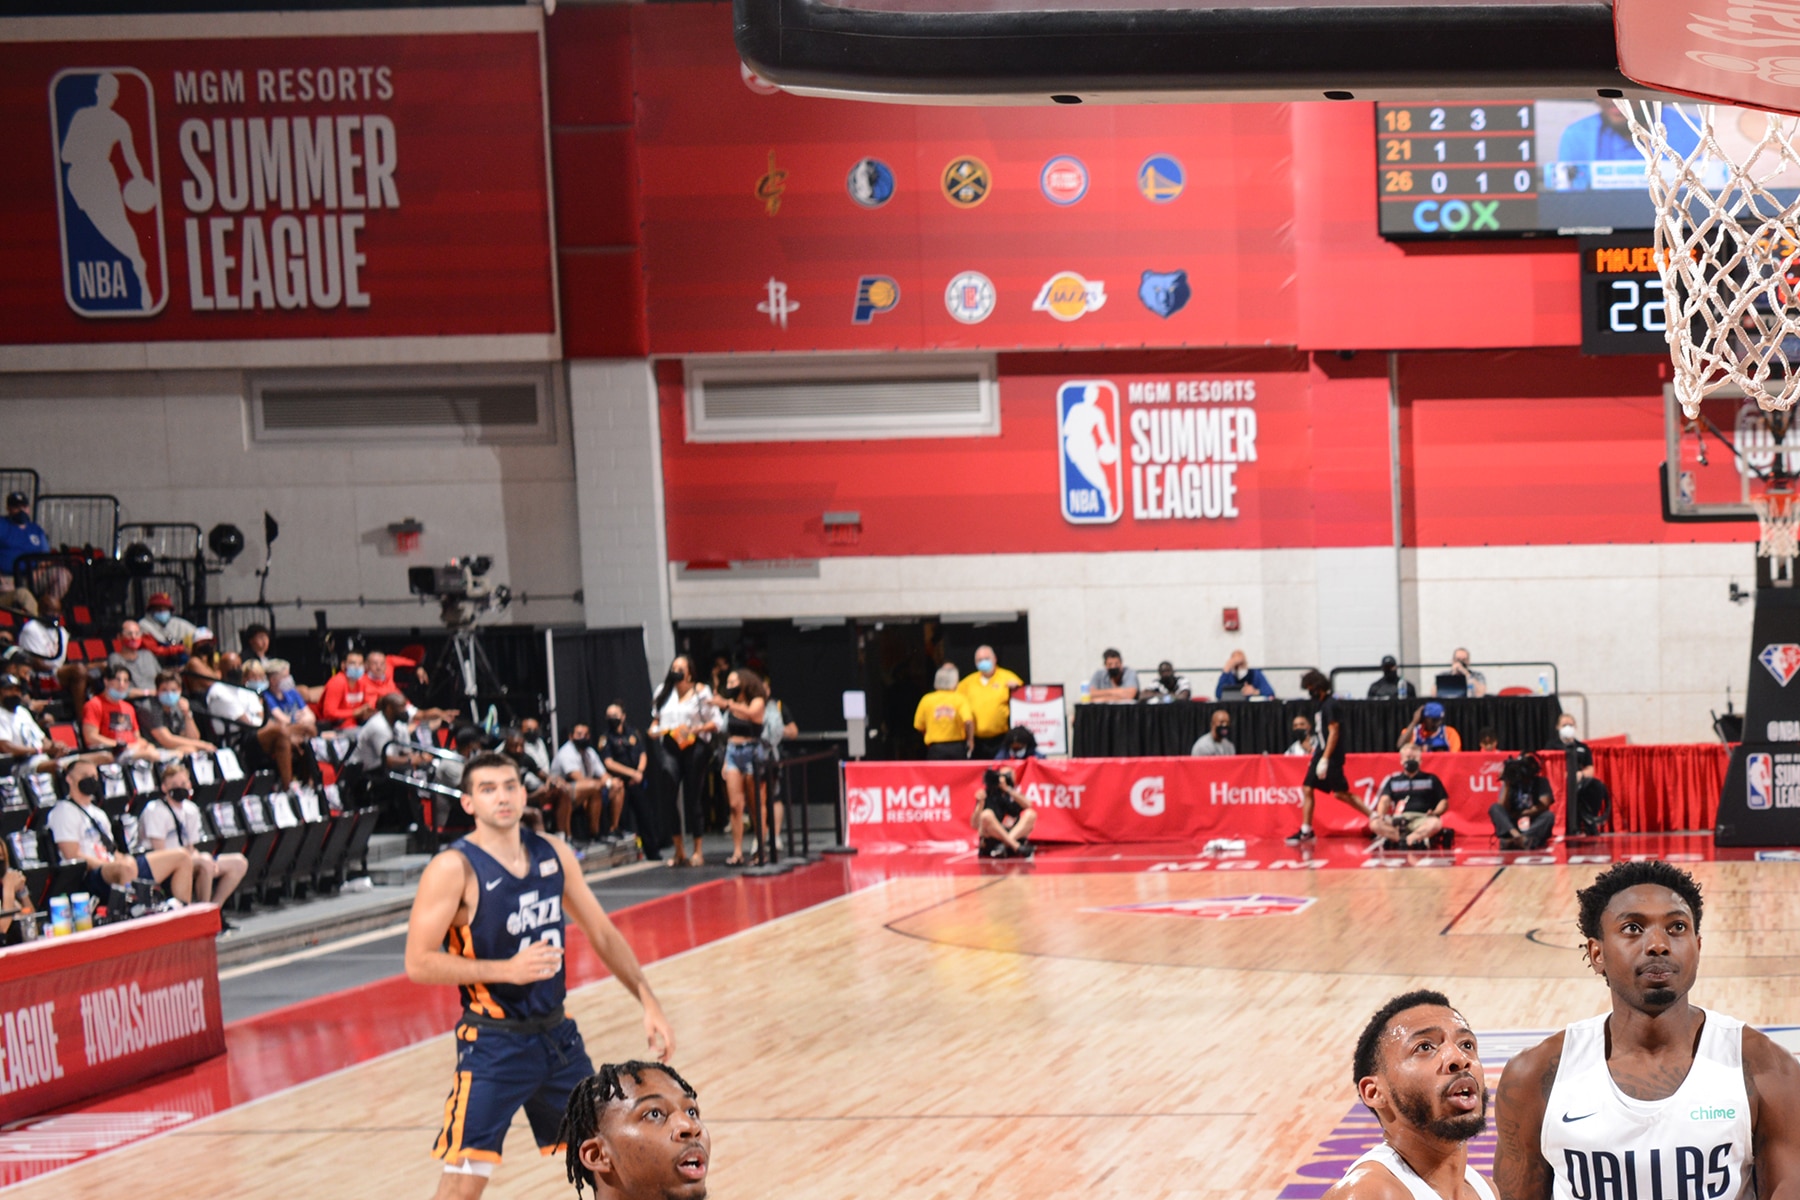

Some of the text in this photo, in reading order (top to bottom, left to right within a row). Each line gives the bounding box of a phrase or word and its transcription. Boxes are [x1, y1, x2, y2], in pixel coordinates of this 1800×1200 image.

[173, 66, 395, 105] MGM RESORTS
[1384, 107, 1530, 132] 18 2 3 1
[178, 114, 400, 213] SUMMER
[1386, 139, 1530, 162] 21 1 1 1
[1386, 169, 1531, 193] 26 0 1 0
[1413, 200, 1500, 232] COX
[185, 213, 371, 311] LEAGUE
[77, 259, 128, 300] NBA
[1610, 280, 1666, 332] 22
[1128, 380, 1256, 405] MGM RESORTS
[1130, 407, 1258, 465] SUMMER
[1068, 488, 1101, 515] NBA
[1133, 464, 1240, 521] LEAGUE
[886, 785, 950, 808] MGM
[1025, 782, 1087, 809] AT&T
[1210, 781, 1306, 808] Hennessy
[1469, 775, 1500, 792] UL
[886, 808, 951, 823] RESORTS
[80, 977, 207, 1067] #NBASummer
[1689, 1105, 1737, 1121] chime
